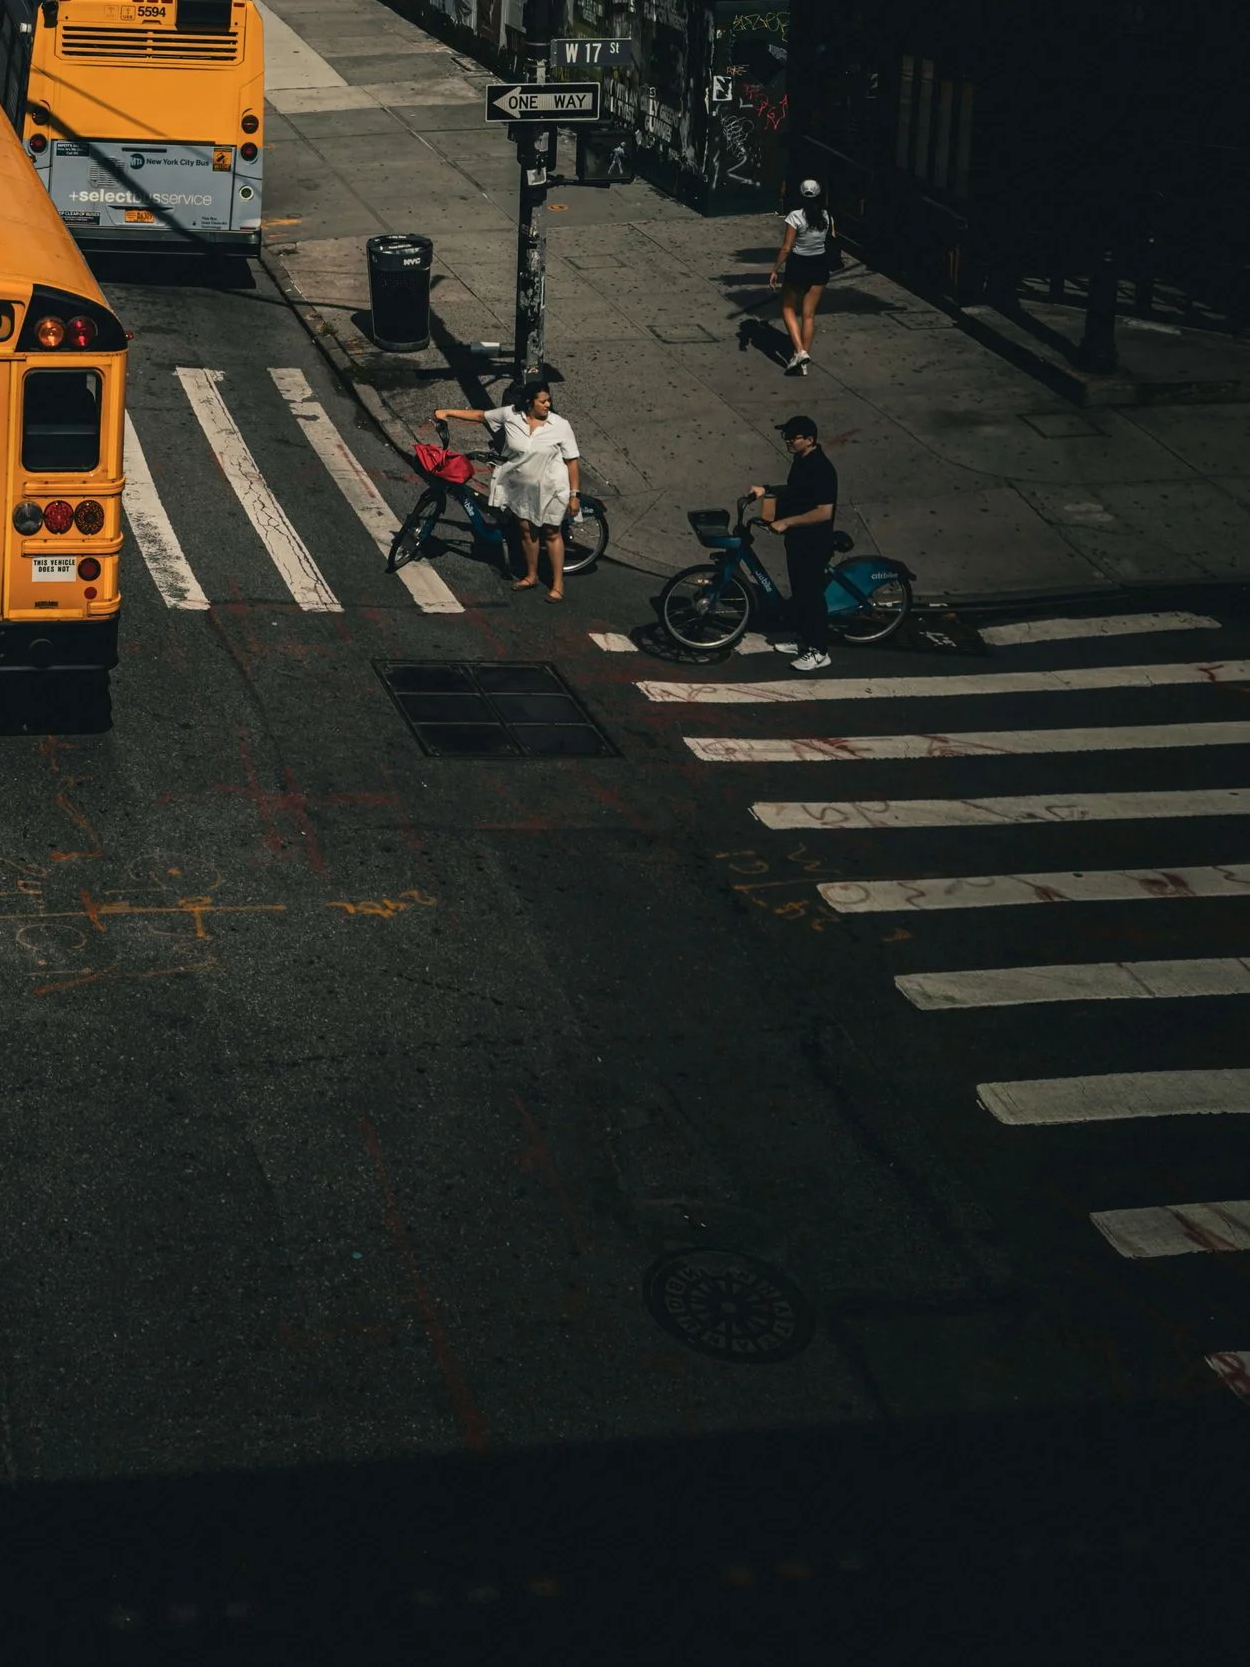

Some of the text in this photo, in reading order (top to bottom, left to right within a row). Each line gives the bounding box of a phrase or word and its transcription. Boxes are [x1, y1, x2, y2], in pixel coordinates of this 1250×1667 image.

[137, 6, 166, 17] 5594
[565, 41, 619, 64] W 17 St
[508, 94, 587, 110] ONE WAY
[146, 158, 161, 166] New
[163, 158, 178, 166] York
[180, 159, 194, 168] City
[403, 257, 421, 266] NYC
